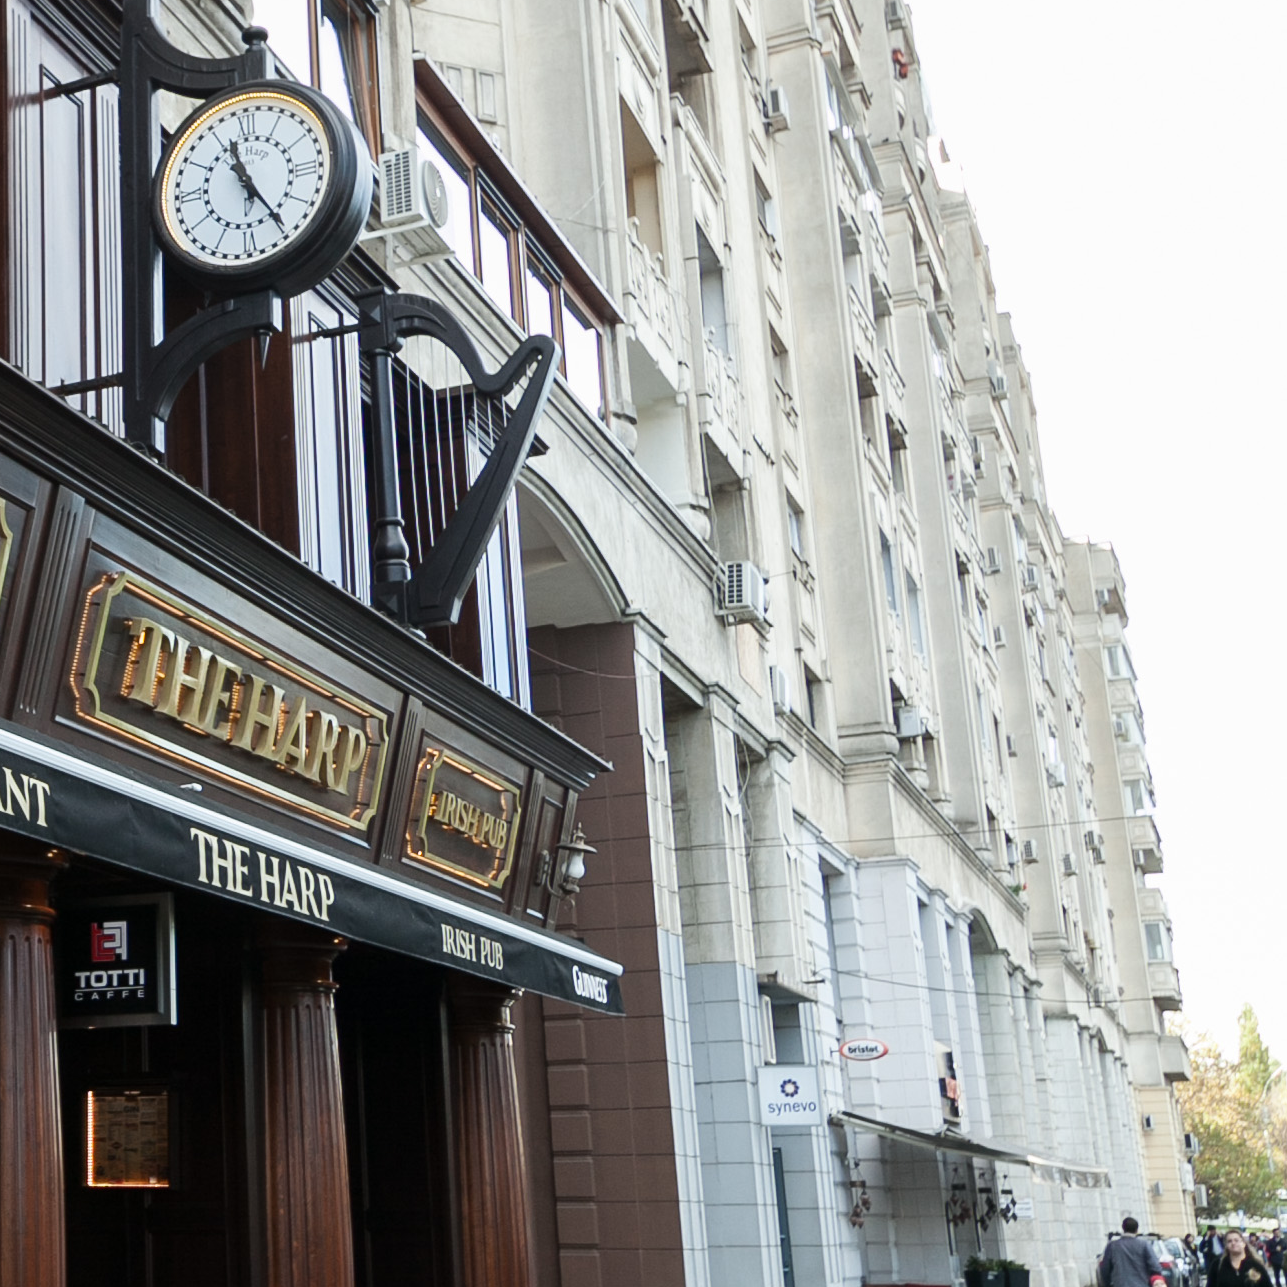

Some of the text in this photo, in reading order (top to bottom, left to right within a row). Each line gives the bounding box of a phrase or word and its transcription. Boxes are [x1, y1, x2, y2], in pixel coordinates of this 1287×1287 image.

[245, 145, 269, 161] Harp
[126, 616, 368, 797] THE HARP
[437, 791, 509, 850] IRISH PUB
[190, 827, 335, 922] THE HARP
[441, 923, 504, 971] IRISH PUB
[74, 968, 145, 988] TOTTI
[74, 989, 145, 1001] CAFFE
[767, 1099, 817, 1117] synevo
